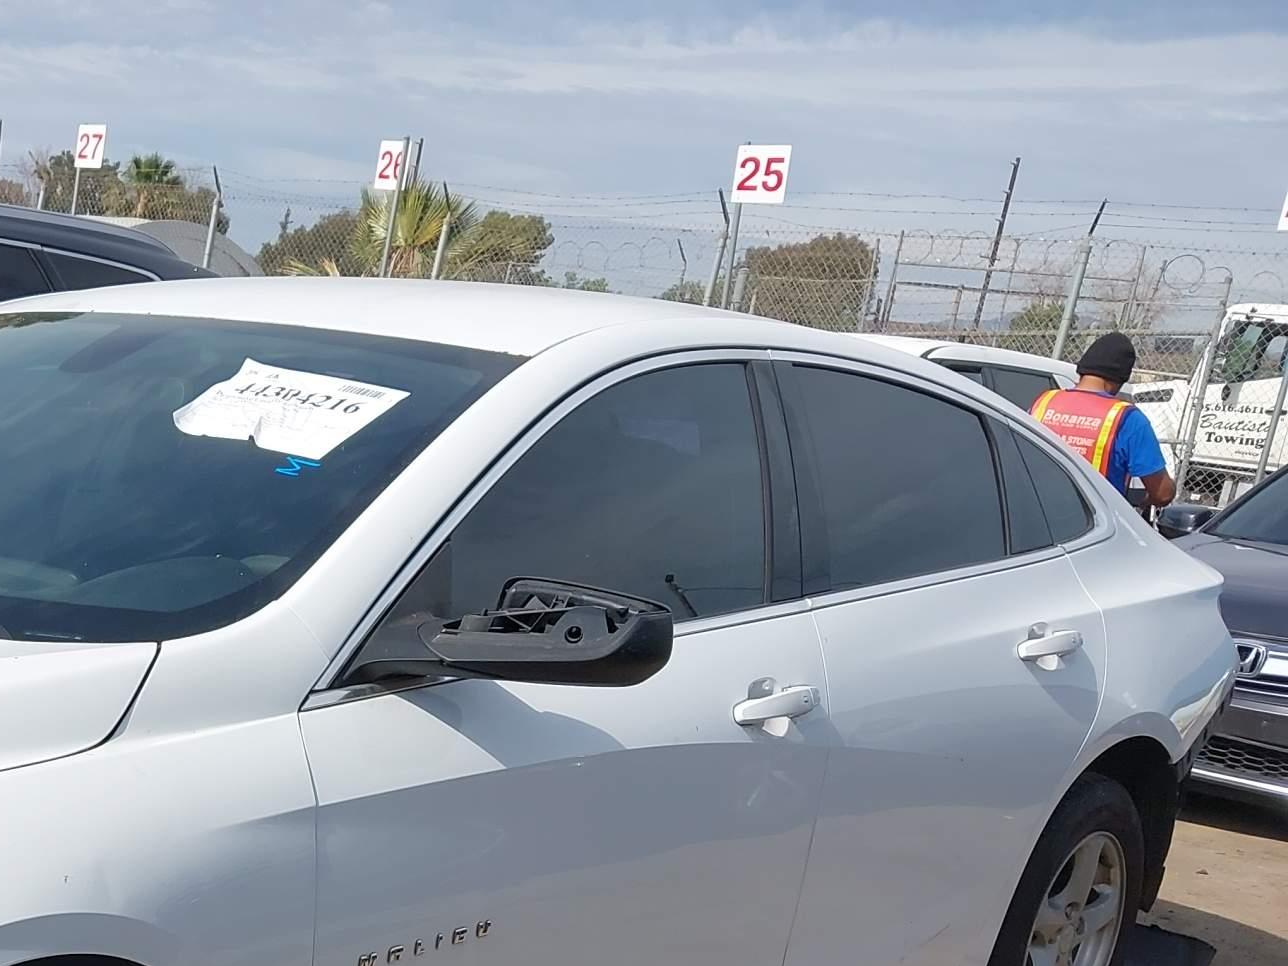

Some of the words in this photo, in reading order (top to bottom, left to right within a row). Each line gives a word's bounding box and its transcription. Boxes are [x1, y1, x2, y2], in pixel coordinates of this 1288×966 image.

[78, 133, 103, 160] 27
[736, 157, 785, 192] 25
[234, 382, 368, 415] 44304216
[1044, 409, 1101, 427] Bonanza
[1205, 431, 1265, 449] Towing
